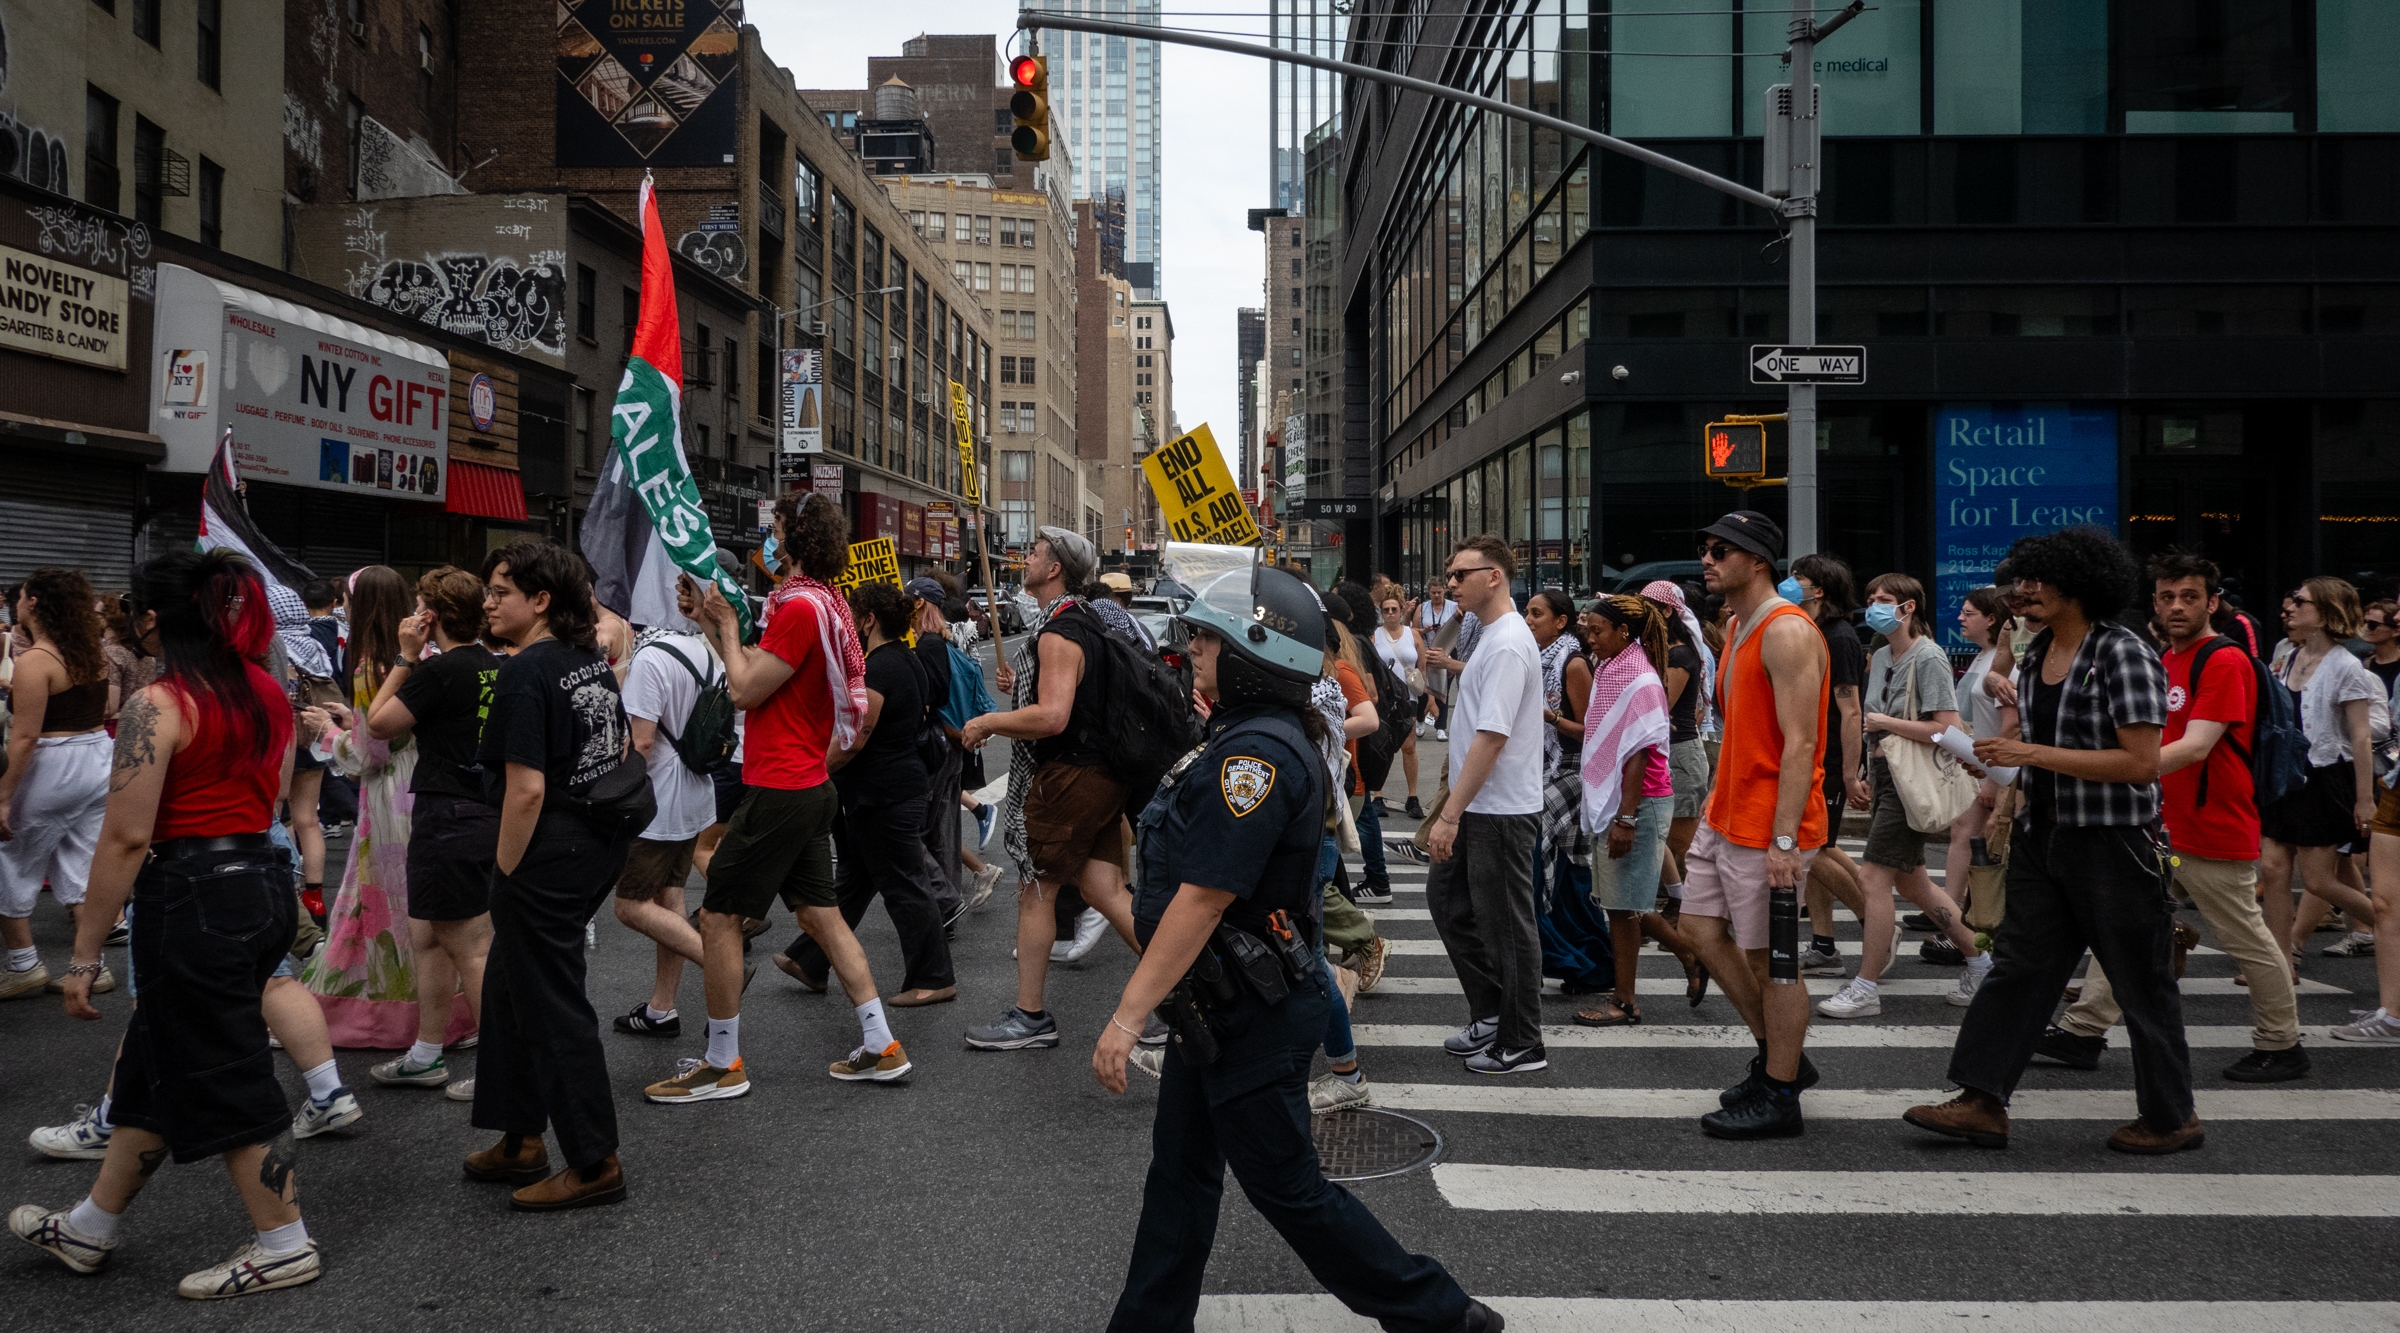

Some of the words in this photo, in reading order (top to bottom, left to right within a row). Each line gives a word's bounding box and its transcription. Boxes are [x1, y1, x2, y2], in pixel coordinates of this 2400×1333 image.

[609, 13, 638, 28] ON
[641, 13, 685, 28] SALE
[617, 37, 677, 46] YANKEES.COM
[1827, 57, 1888, 72] medical
[6, 257, 95, 301] NOVELTY
[60, 300, 119, 335] STORE
[229, 314, 276, 338] WHOLESALE
[56, 329, 65, 344] &
[68, 333, 109, 354] CANDY
[318, 341, 343, 357] WINTEX
[344, 345, 370, 364] COTTON
[370, 354, 383, 367] INC.
[1767, 357, 1800, 372] ONE
[1819, 357, 1855, 372] WAY
[427, 371, 446, 384] RETAIL
[810, 350, 823, 384] NOMAD
[173, 375, 194, 386] NY
[300, 354, 356, 413] NY
[368, 374, 446, 431] GIFT
[174, 411, 186, 419] NY
[783, 380, 795, 429] FLATIRON
[235, 402, 270, 419] LUGGAGE
[274, 411, 306, 426] PERFUME
[311, 418, 328, 430] BODY
[329, 420, 343, 433] OILS
[347, 426, 379, 441] SOUVENIRS
[383, 433, 402, 445] PHONE
[402, 435, 437, 450] ACCESSORIES
[1949, 417, 2046, 446] Retail
[1156, 435, 1203, 481] END
[814, 465, 842, 479] NUZHAT
[815, 479, 841, 487] PERFUMES
[1948, 457, 2046, 496] Space
[1174, 467, 1217, 508] ALL
[1173, 511, 1212, 543] U.S.
[1207, 491, 1243, 528] AID
[1320, 504, 1332, 514] 50
[1334, 504, 1343, 514] W
[1345, 504, 1357, 514] 30
[1949, 498, 1998, 527] for
[2010, 498, 2104, 526] Lease
[852, 539, 892, 561] WITH
[1948, 545, 1979, 556] Ross
[1227, 765, 1271, 780] DEPARTMENT
[1238, 759, 1263, 769] POLICE
[1224, 778, 1232, 794] CITY
[1228, 795, 1236, 804] OF
[1242, 798, 1257, 811] NEW
[1255, 783, 1269, 800] YORK
